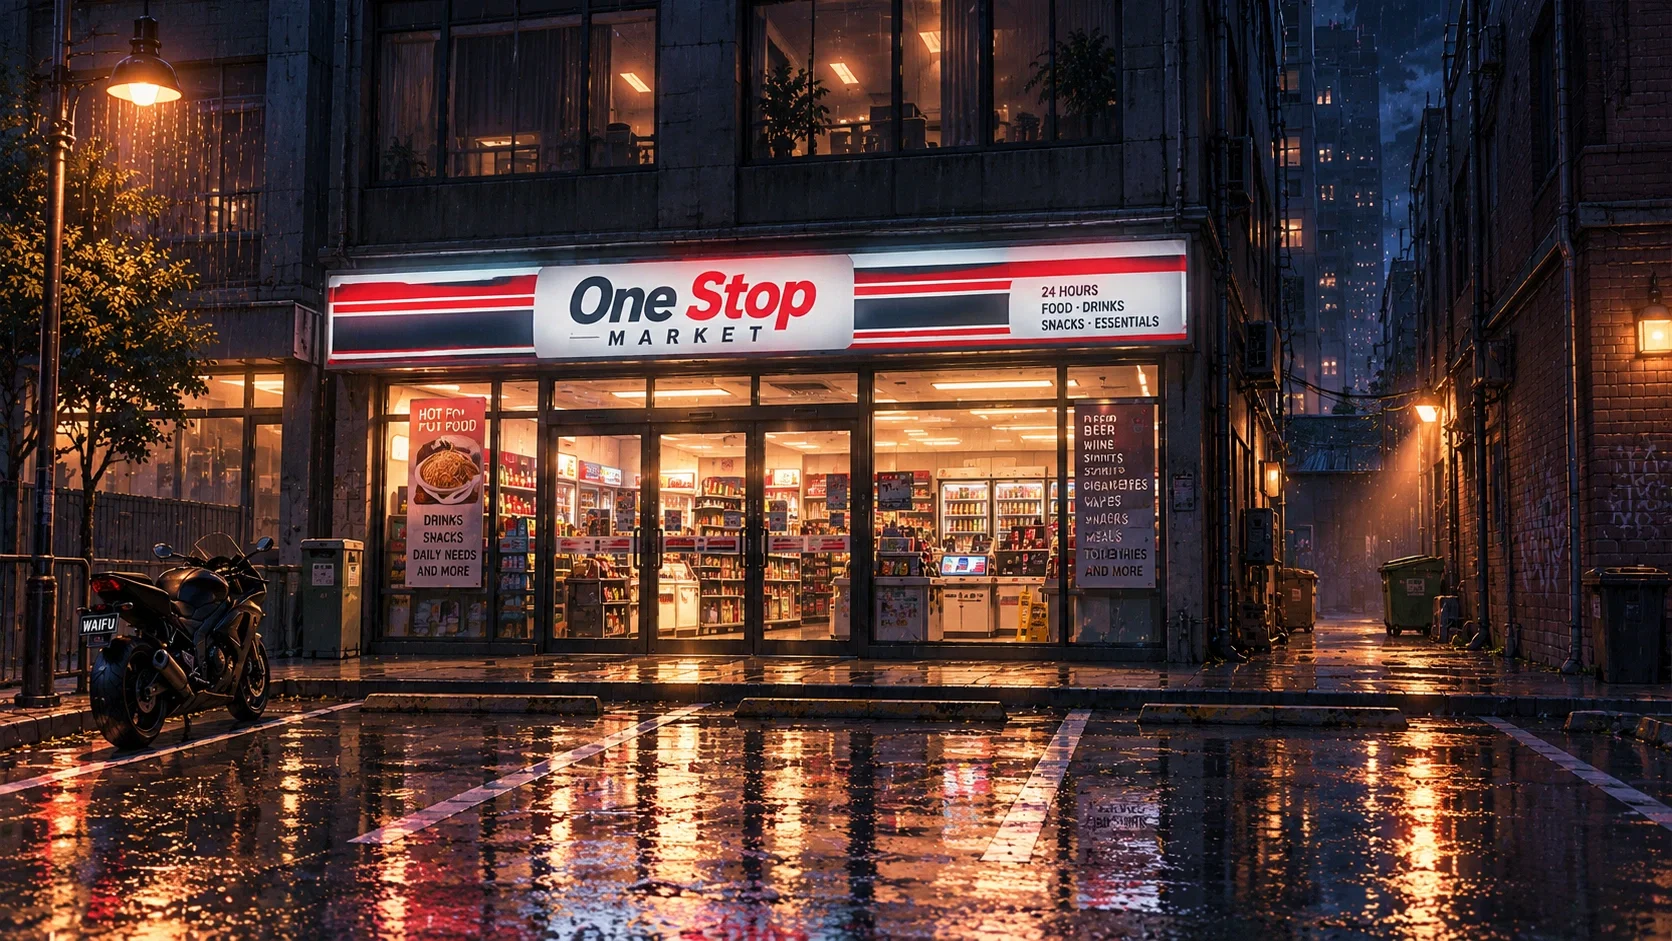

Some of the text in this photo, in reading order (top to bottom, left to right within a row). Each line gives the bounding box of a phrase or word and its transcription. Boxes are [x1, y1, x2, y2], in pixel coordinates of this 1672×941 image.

[1042, 284, 1099, 298] 24 HOURS
[569, 271, 817, 331] One Stop
[1042, 300, 1125, 315] FOOD DRINKS
[1042, 315, 1160, 331] SNACKS ESSENTIALS
[608, 326, 762, 346] MARKET
[419, 408, 443, 421] HOT
[445, 420, 477, 432] FOOD
[1084, 424, 1115, 437] BEER
[423, 514, 464, 526] DRINKS
[423, 532, 464, 543] SNACKS
[413, 549, 477, 560] DAILY NEEDS
[417, 566, 470, 577] AND MORE
[1085, 565, 1143, 577] AND MORE
[83, 618, 116, 633] WAIFU
